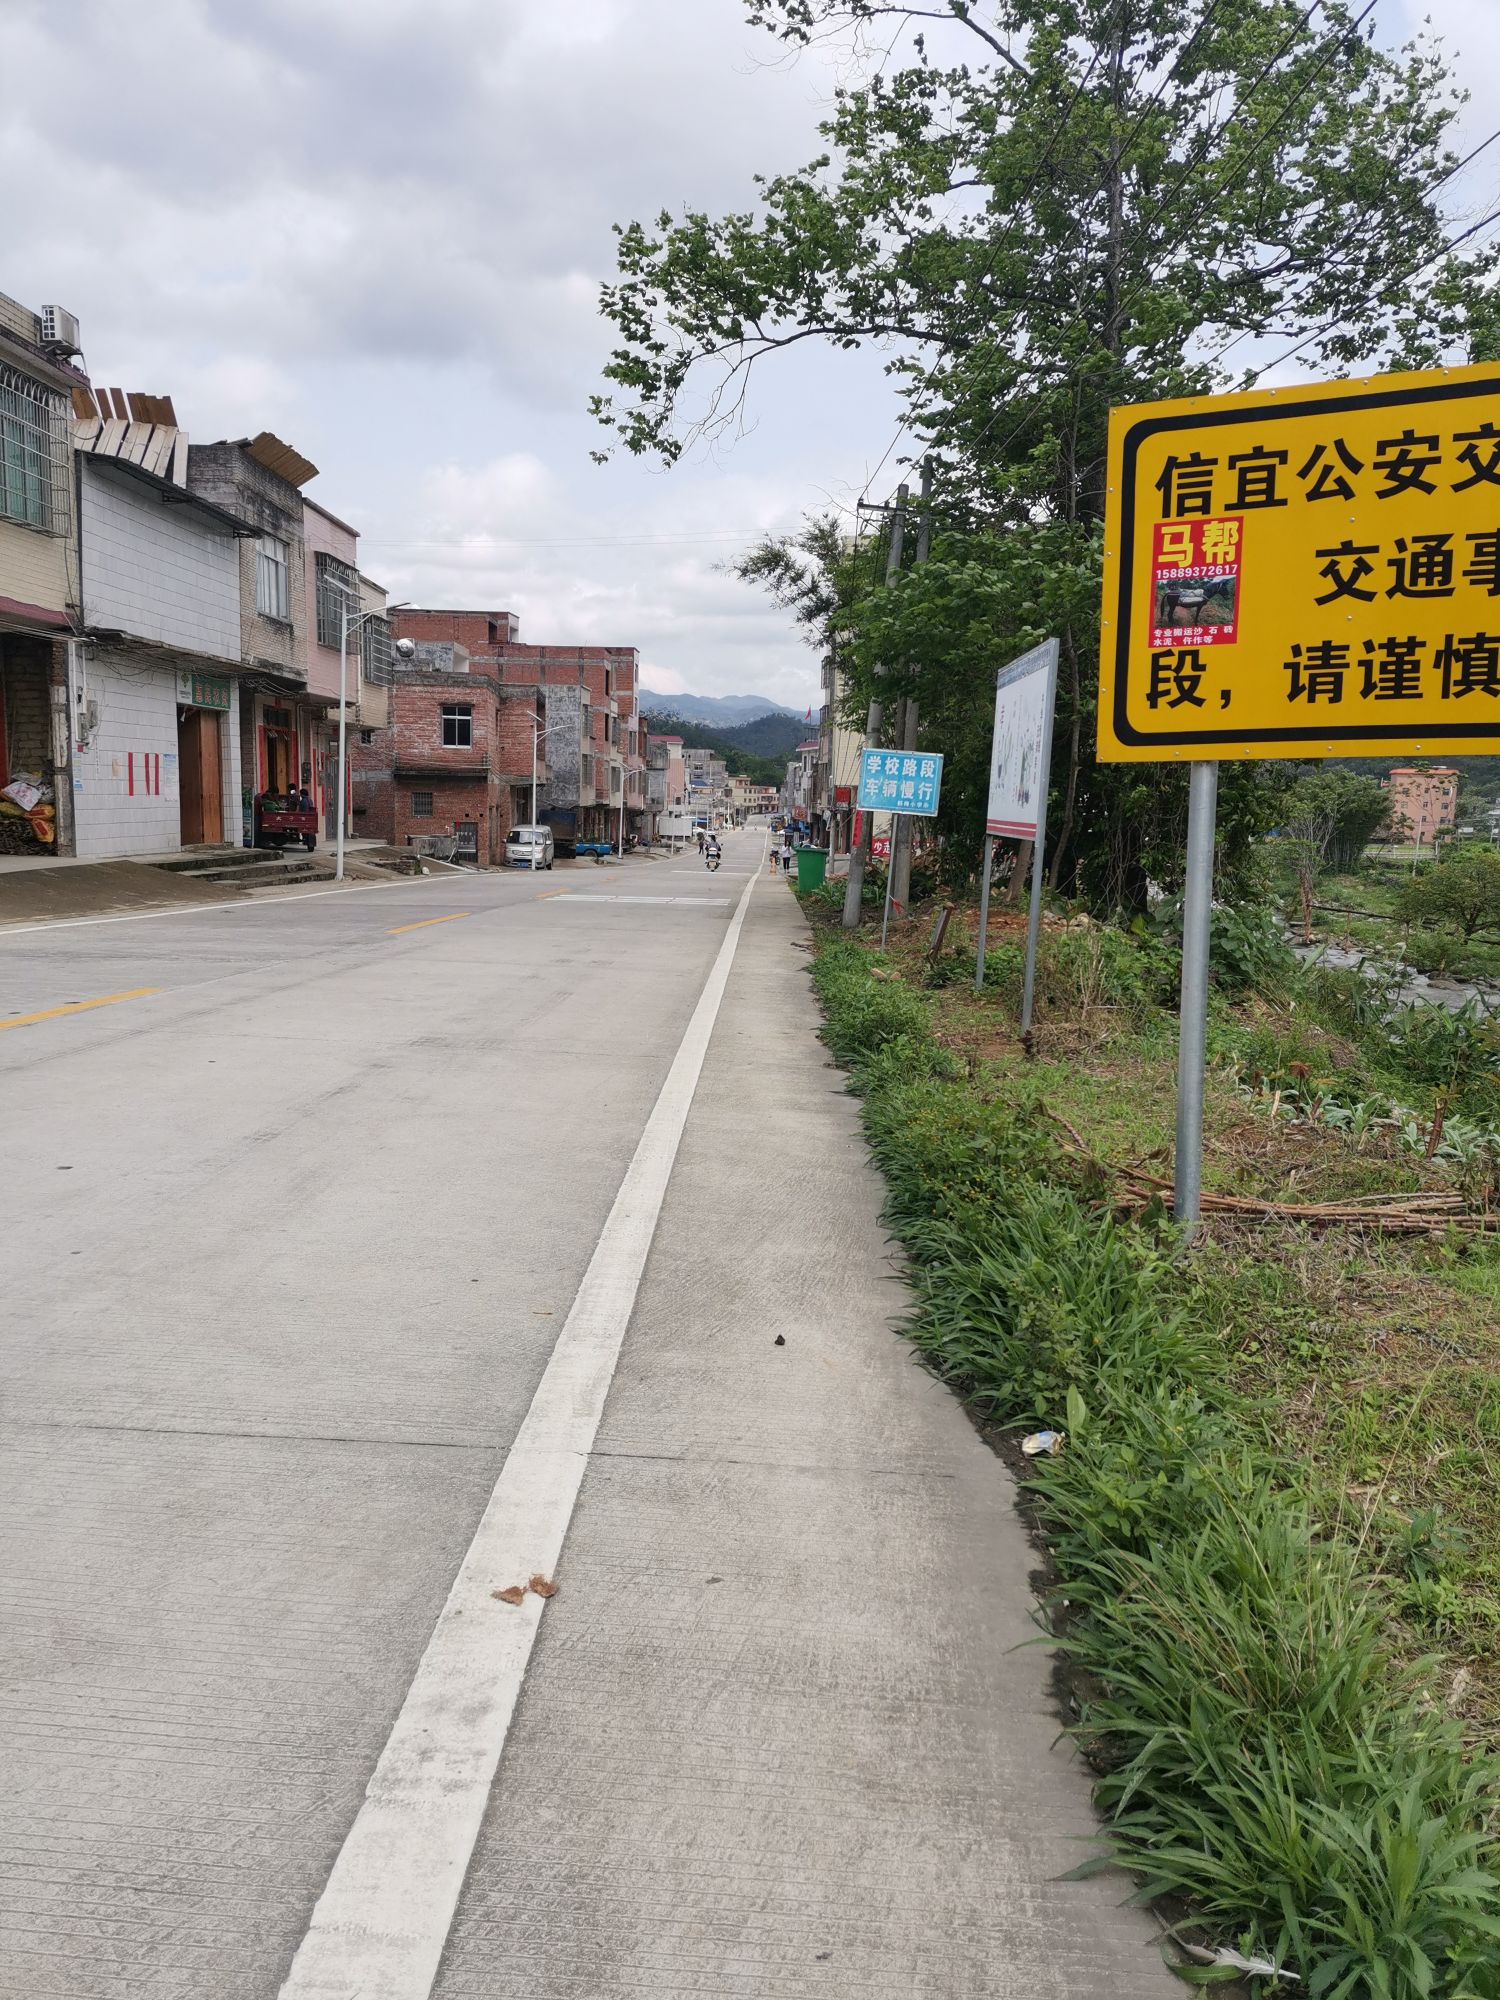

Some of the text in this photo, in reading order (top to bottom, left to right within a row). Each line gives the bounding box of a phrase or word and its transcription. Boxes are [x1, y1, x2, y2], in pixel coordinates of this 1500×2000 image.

[1155, 422, 1500, 518] 信宜公安交
[1158, 521, 1239, 567] 马帮
[1156, 564, 1238, 579] 15889372617
[1314, 527, 1500, 606] 交通事
[867, 755, 935, 778] 学校路段
[865, 778, 933, 801] 车辆慢行
